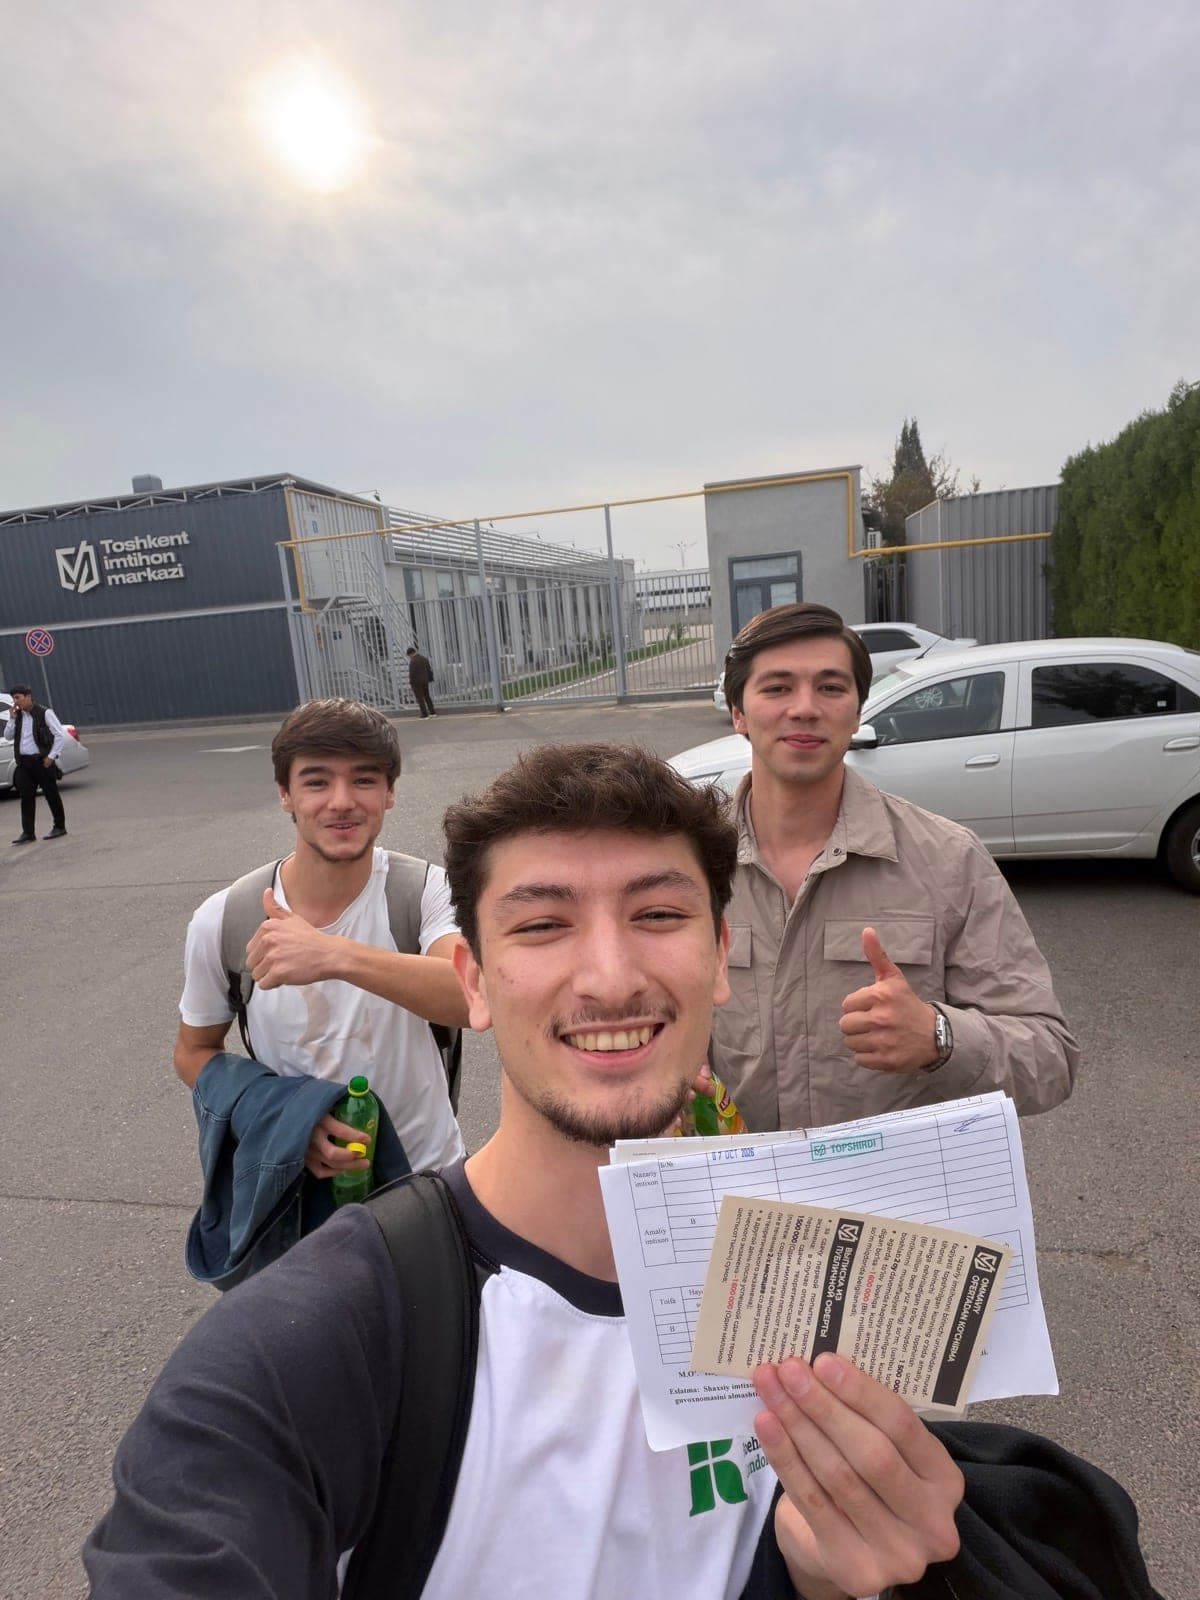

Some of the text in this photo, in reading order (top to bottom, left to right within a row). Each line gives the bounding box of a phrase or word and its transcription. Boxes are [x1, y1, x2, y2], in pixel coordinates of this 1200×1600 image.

[100, 530, 190, 554] Toshkent
[103, 551, 176, 570] imtihon
[107, 563, 185, 586] markazi
[831, 1139, 877, 1154] TOPSHIRDI
[632, 1171, 657, 1180] Nazariy
[634, 1179, 659, 1187] imtixon
[834, 1246, 852, 1301] ВЫПИСКА ИЗ
[817, 1245, 845, 1337] ПУБЛИЧНОЙ ОФЕРТЫ
[959, 1274, 980, 1320] OFERTADAN
[971, 1276, 990, 1314] OMMAVIY
[669, 1387, 700, 1395] Eslatma:
[703, 1385, 729, 1393] Shaxsiy
